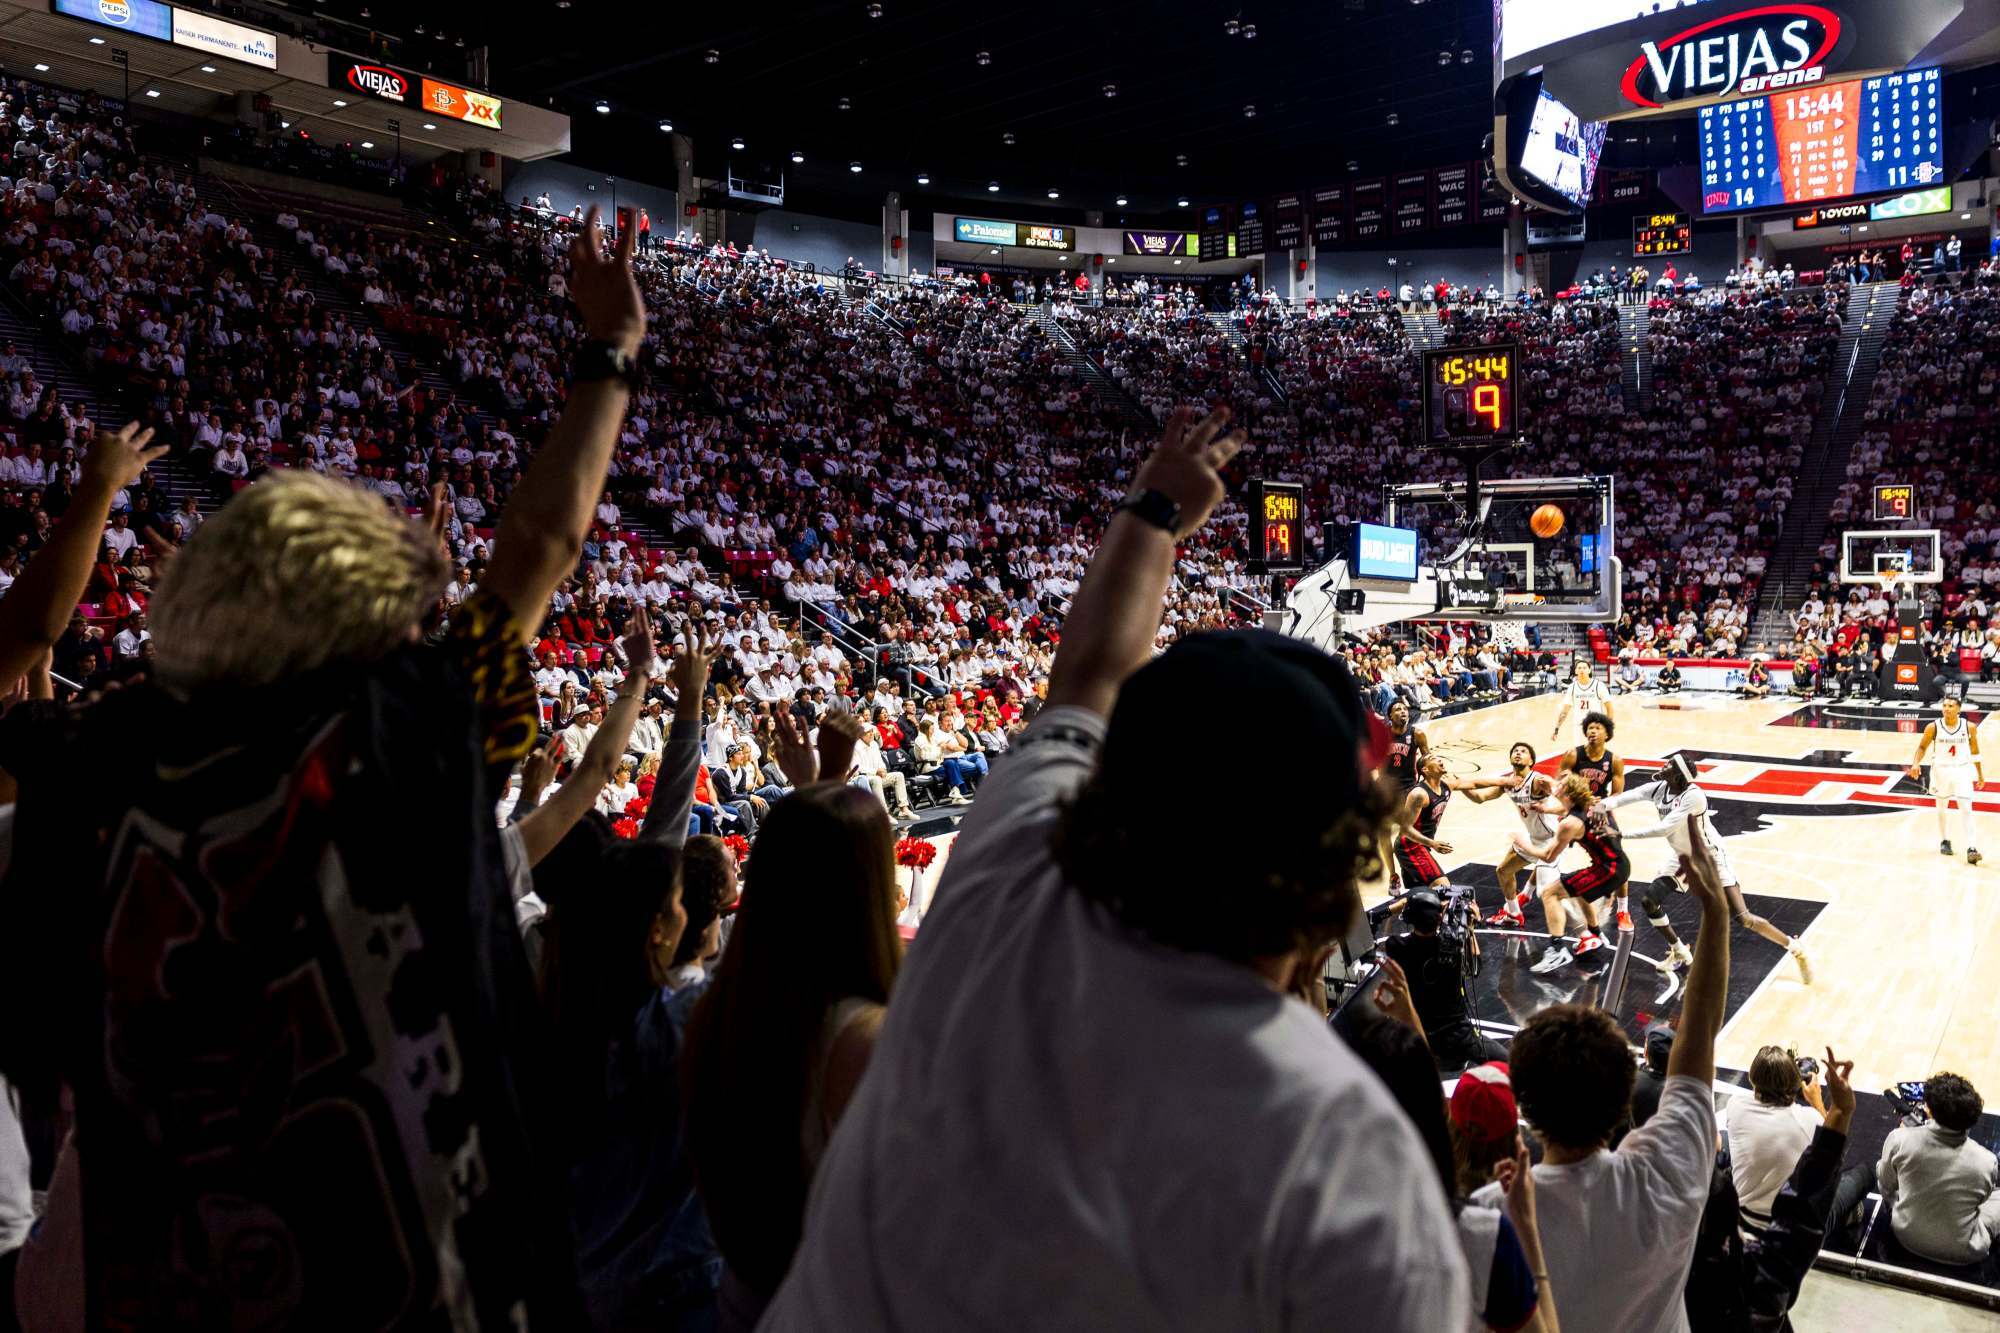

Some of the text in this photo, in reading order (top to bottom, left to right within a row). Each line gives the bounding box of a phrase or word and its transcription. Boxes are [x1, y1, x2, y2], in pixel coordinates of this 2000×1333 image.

[101, 3, 129, 15] PEPSI
[175, 27, 197, 39] KAISER
[243, 44, 275, 60] thrive
[1641, 19, 1810, 97] VIEJAS
[354, 65, 400, 95] VIEJAS
[1740, 66, 1824, 94] arena
[1888, 76, 1902, 87] PTS
[1871, 91, 1878, 103] 0
[1911, 85, 1918, 96] 0
[1928, 82, 1935, 94] 0
[471, 102, 494, 121] XX
[1719, 104, 1732, 115] PTS
[1786, 90, 1844, 120] 15:44
[1872, 97, 1936, 117] 4 2 0 0
[112, 116, 123, 127] G
[1704, 119, 1711, 130] 0
[1723, 116, 1730, 127] 6
[1740, 113, 1747, 124] 0
[1806, 120, 1825, 135] 1ST
[1893, 112, 1936, 129] 0 0 0
[203, 136, 211, 146] F
[1706, 133, 1712, 144] 2
[1723, 130, 1730, 141] 2
[1756, 125, 1763, 136] 0
[1872, 127, 1936, 147] 21 6 0 0
[1741, 141, 1748, 152] 0
[1756, 139, 1763, 150] 0
[1893, 147, 1901, 158] 0
[1913, 144, 1920, 156] 0
[1929, 142, 1937, 153] 0
[1706, 153, 1764, 171] 10 0 0 0
[389, 178, 395, 187] F
[1706, 174, 1718, 185] 22
[1742, 169, 1749, 180] 0
[1757, 167, 1764, 178] 0
[1888, 166, 1907, 186] 11
[1438, 181, 1465, 192] WAC
[1706, 192, 1730, 209] UNLV
[1735, 187, 1754, 206] 14
[1442, 211, 1463, 222] 1985
[1483, 206, 1505, 217] 2002
[1820, 204, 1867, 220] TOYOTA
[1401, 218, 1421, 228] 1978
[1651, 215, 1675, 226] 15:44
[606, 226, 612, 234] E
[973, 224, 1012, 237] Palomar
[1359, 225, 1378, 235] 1977
[1679, 228, 1688, 237] 14
[658, 237, 664, 245] D
[1049, 240, 1068, 249] Diego
[1143, 234, 1167, 246] VIEJAS
[807, 263, 814, 271] D
[1443, 356, 1507, 384] 15:44
[1474, 385, 1500, 429] 9
[1881, 488, 1909, 500] 15:44
[1895, 498, 1906, 515] 9
[1279, 524, 1289, 554] 9
[1361, 539, 1415, 565] BUD LIGHT
[1458, 589, 1490, 604] San Diego Zoo
[1894, 683, 1920, 691] TOYOTA
[1580, 700, 1589, 709] 21
[1948, 745, 1956, 756] 4
